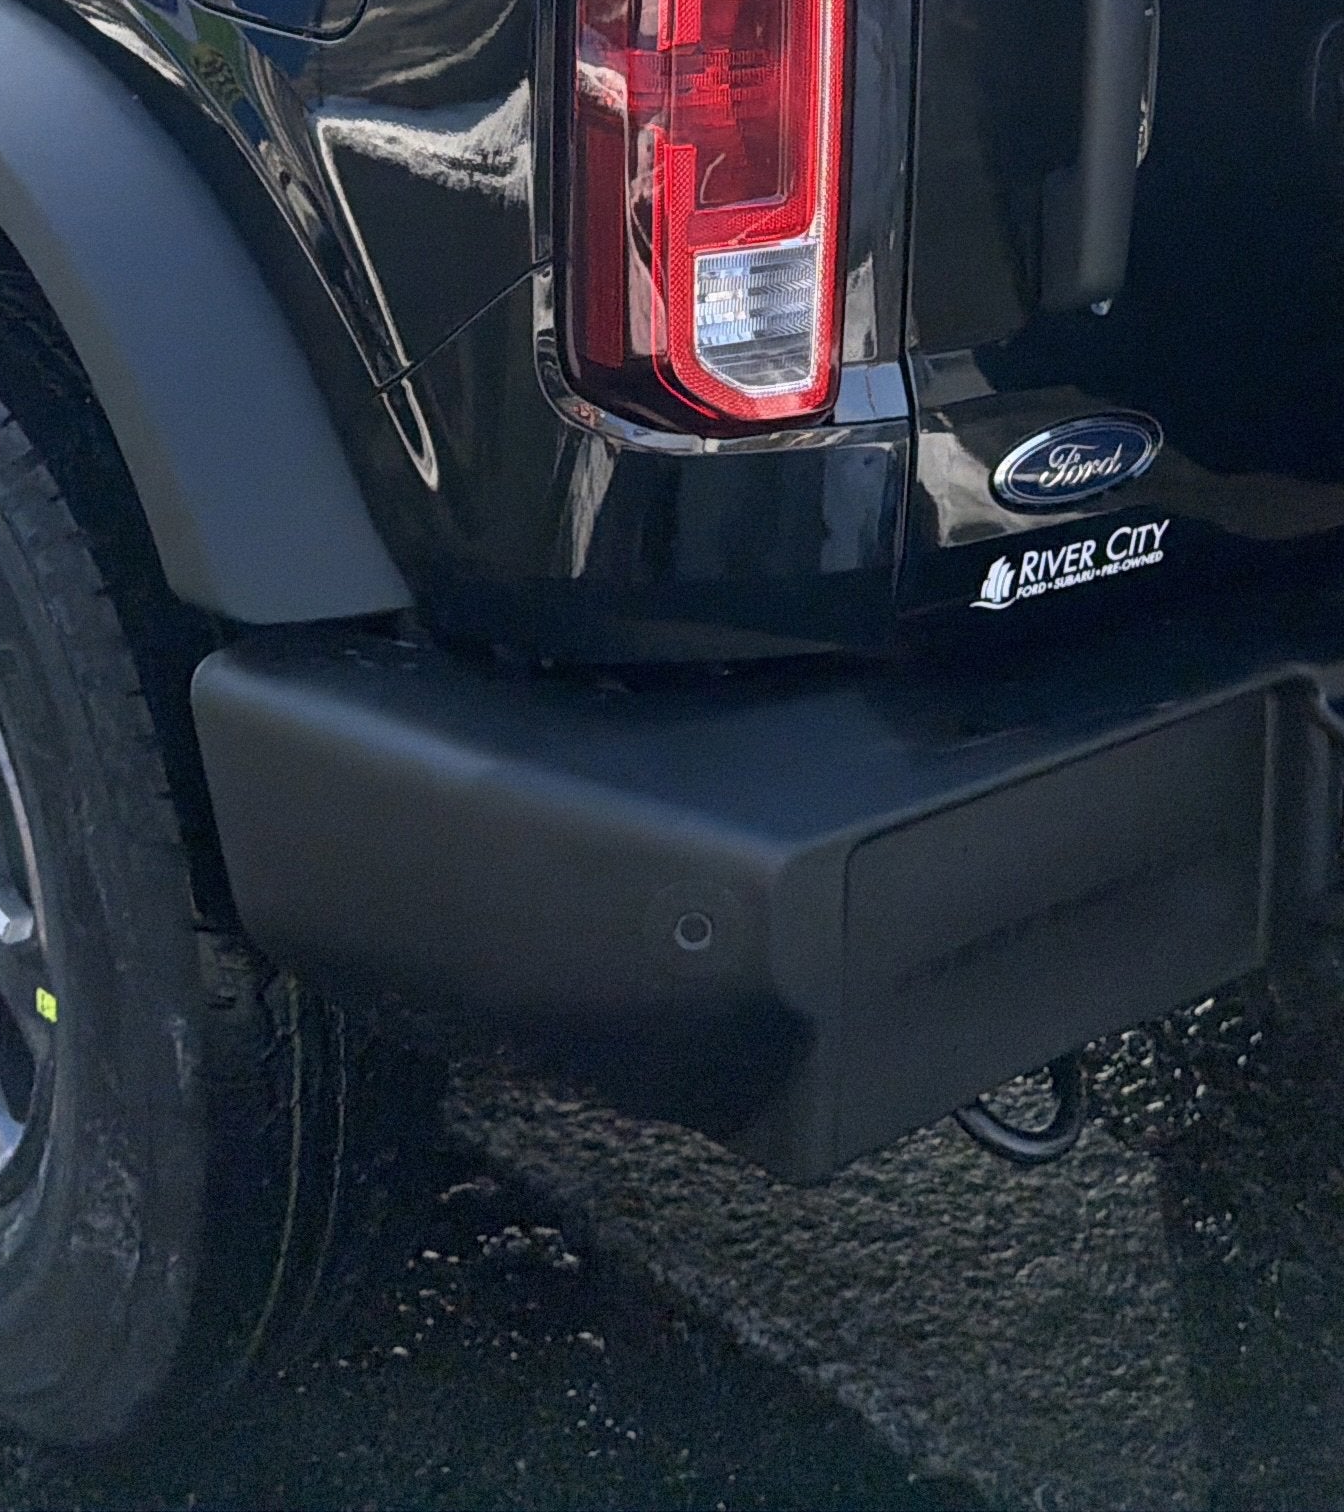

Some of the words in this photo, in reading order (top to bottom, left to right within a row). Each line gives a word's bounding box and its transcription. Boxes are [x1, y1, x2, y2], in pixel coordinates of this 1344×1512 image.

[1038, 442, 1123, 488] Ford
[1016, 582, 1047, 600] FORD
[1054, 567, 1096, 590] SUBARU
[1101, 549, 1164, 577] PRE-OWNED
[1019, 539, 1097, 585] RIVER
[1106, 519, 1170, 561] CITY
